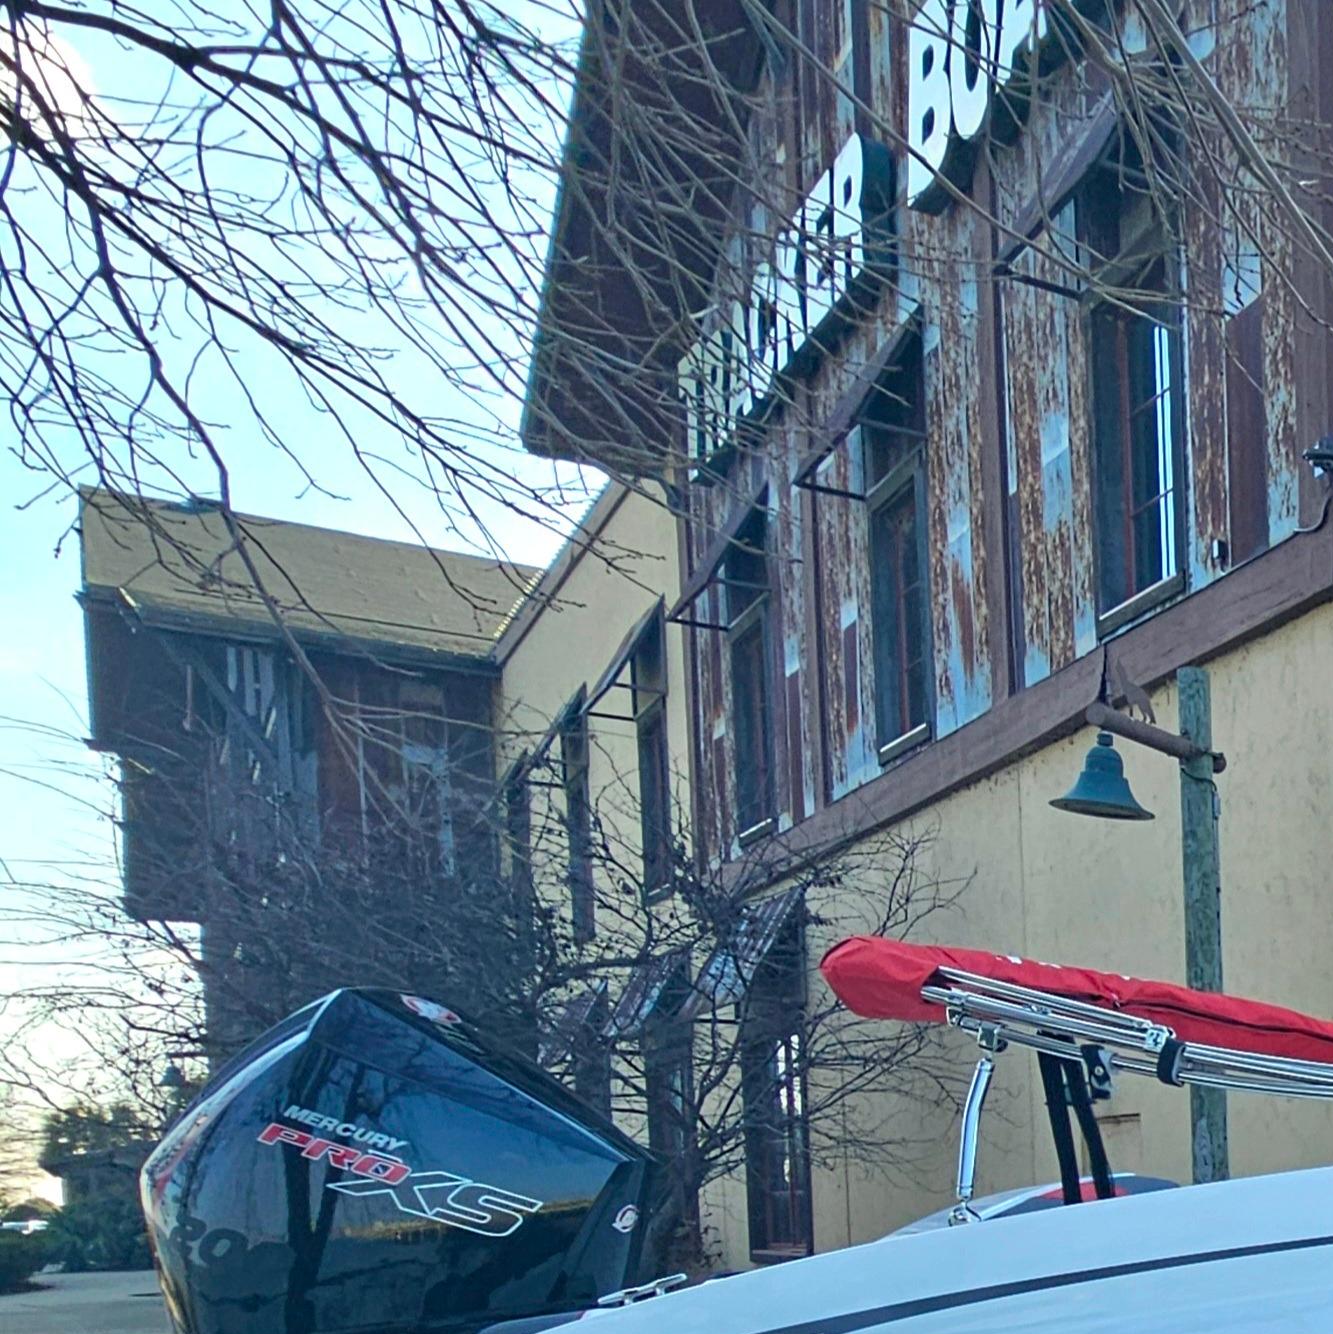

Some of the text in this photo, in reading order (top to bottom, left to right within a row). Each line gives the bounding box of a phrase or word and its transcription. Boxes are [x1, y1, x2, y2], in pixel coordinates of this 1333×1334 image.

[256, 1122, 412, 1186] PRO
[283, 1104, 412, 1152] MERCURY
[326, 1171, 545, 1238] XS
